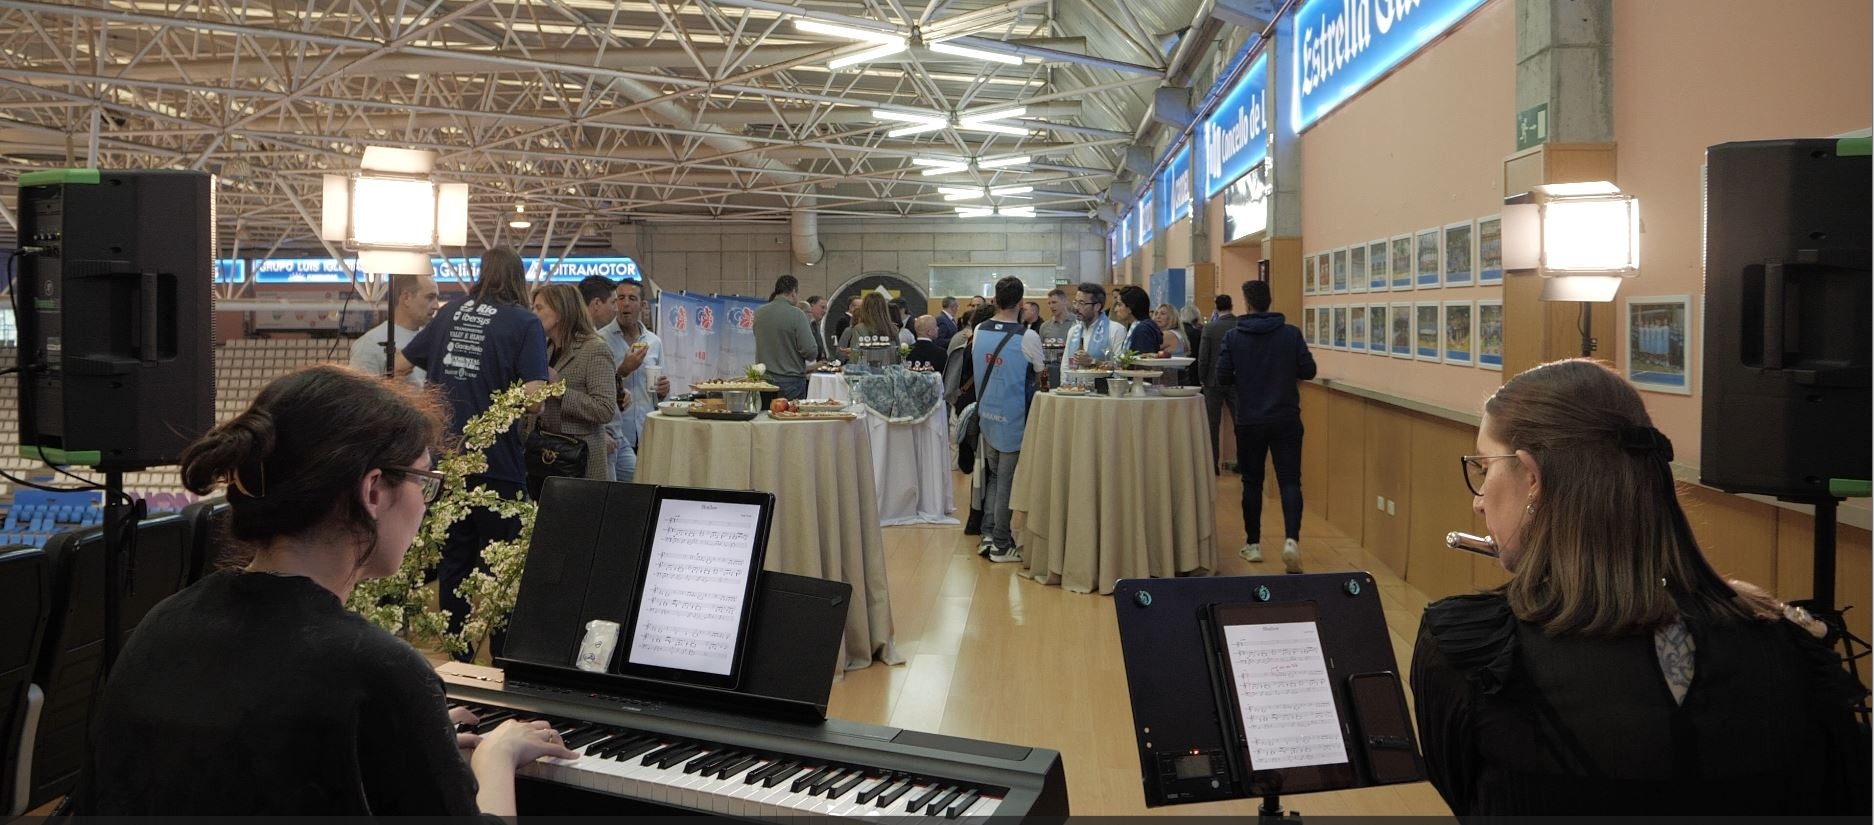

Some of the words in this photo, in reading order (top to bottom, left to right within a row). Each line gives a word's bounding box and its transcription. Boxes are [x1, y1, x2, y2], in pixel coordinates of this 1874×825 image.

[1302, 0, 1371, 97] Estrella
[1222, 106, 1248, 163] Concello
[1250, 94, 1261, 139] de
[259, 260, 294, 272] GRUPO
[297, 260, 319, 272] LUIS
[984, 353, 1004, 366] Ro
